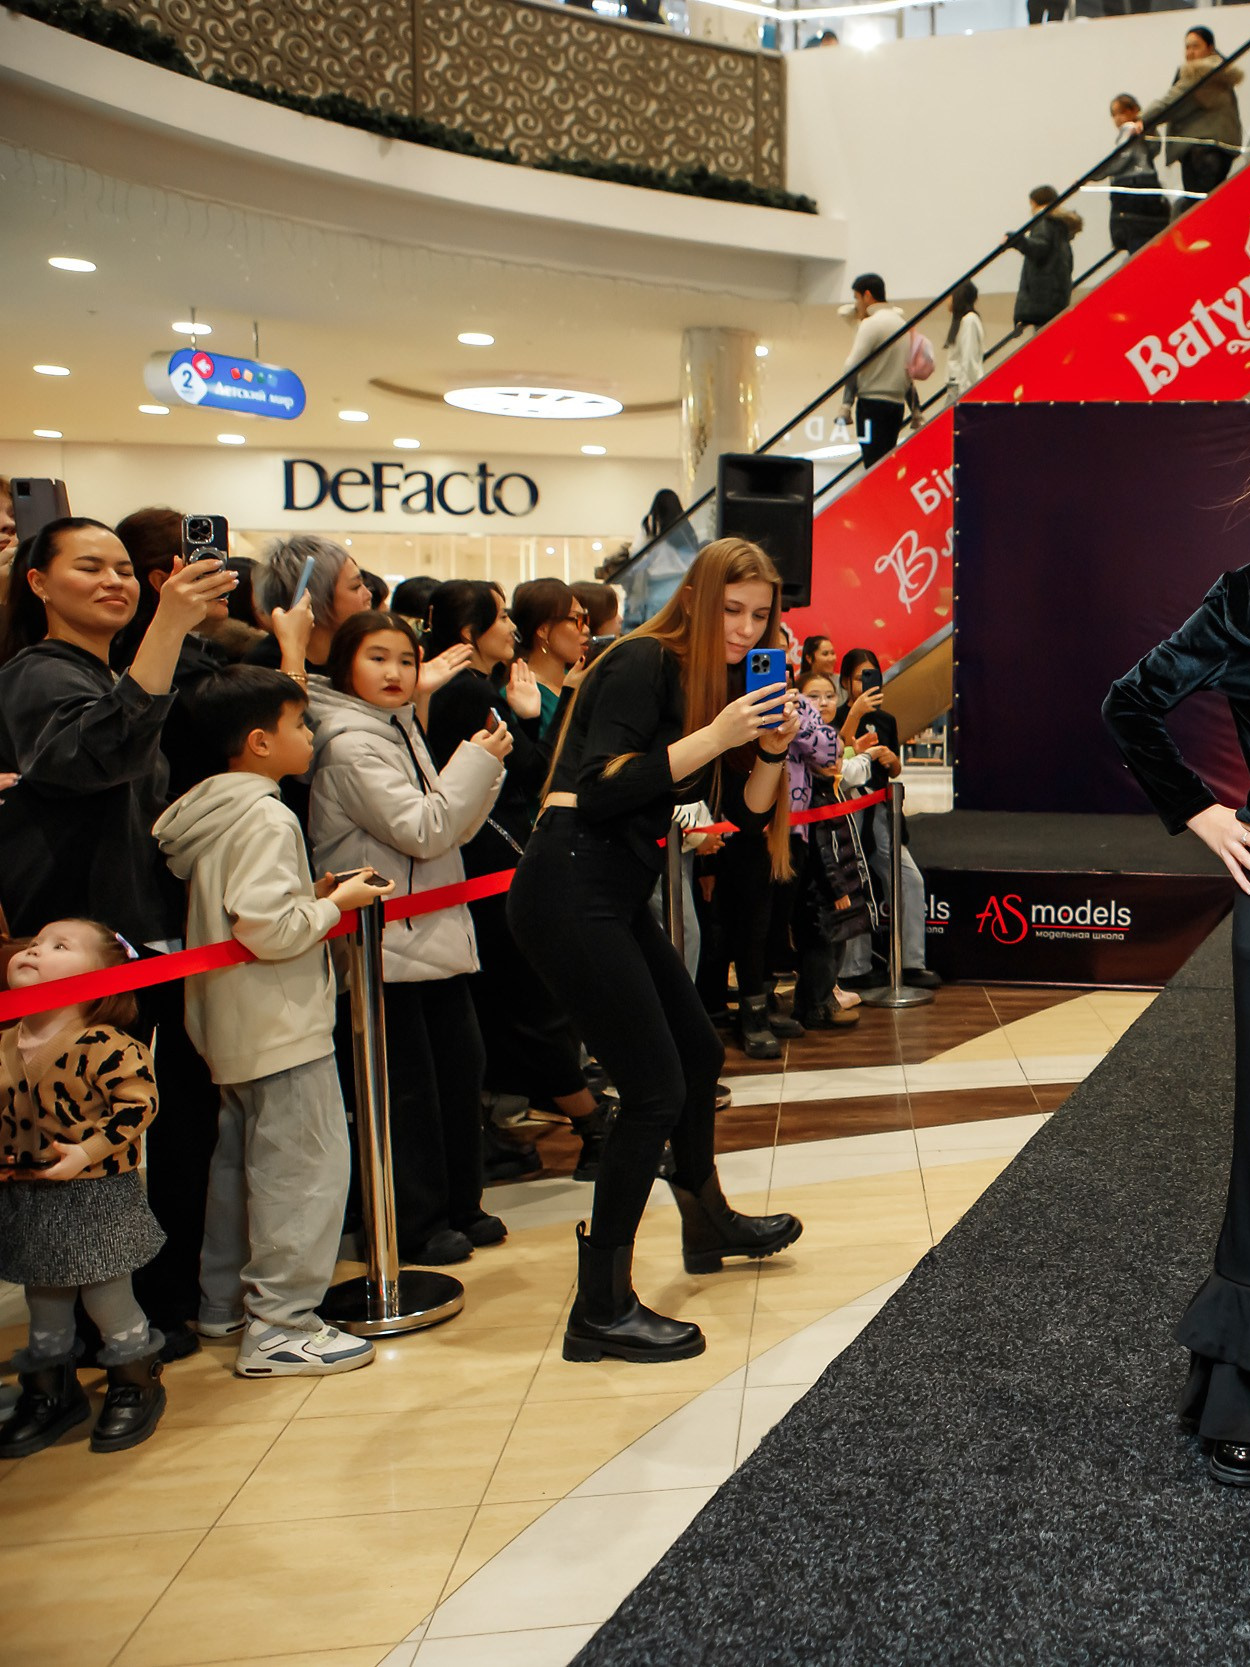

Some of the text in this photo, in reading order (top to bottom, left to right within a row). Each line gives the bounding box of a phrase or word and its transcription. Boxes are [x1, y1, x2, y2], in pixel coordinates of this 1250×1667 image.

[182, 370, 193, 388] 2
[283, 459, 539, 517] DeFacto
[976, 894, 1132, 944] AS models
[1036, 930, 1125, 941] модельная школа
